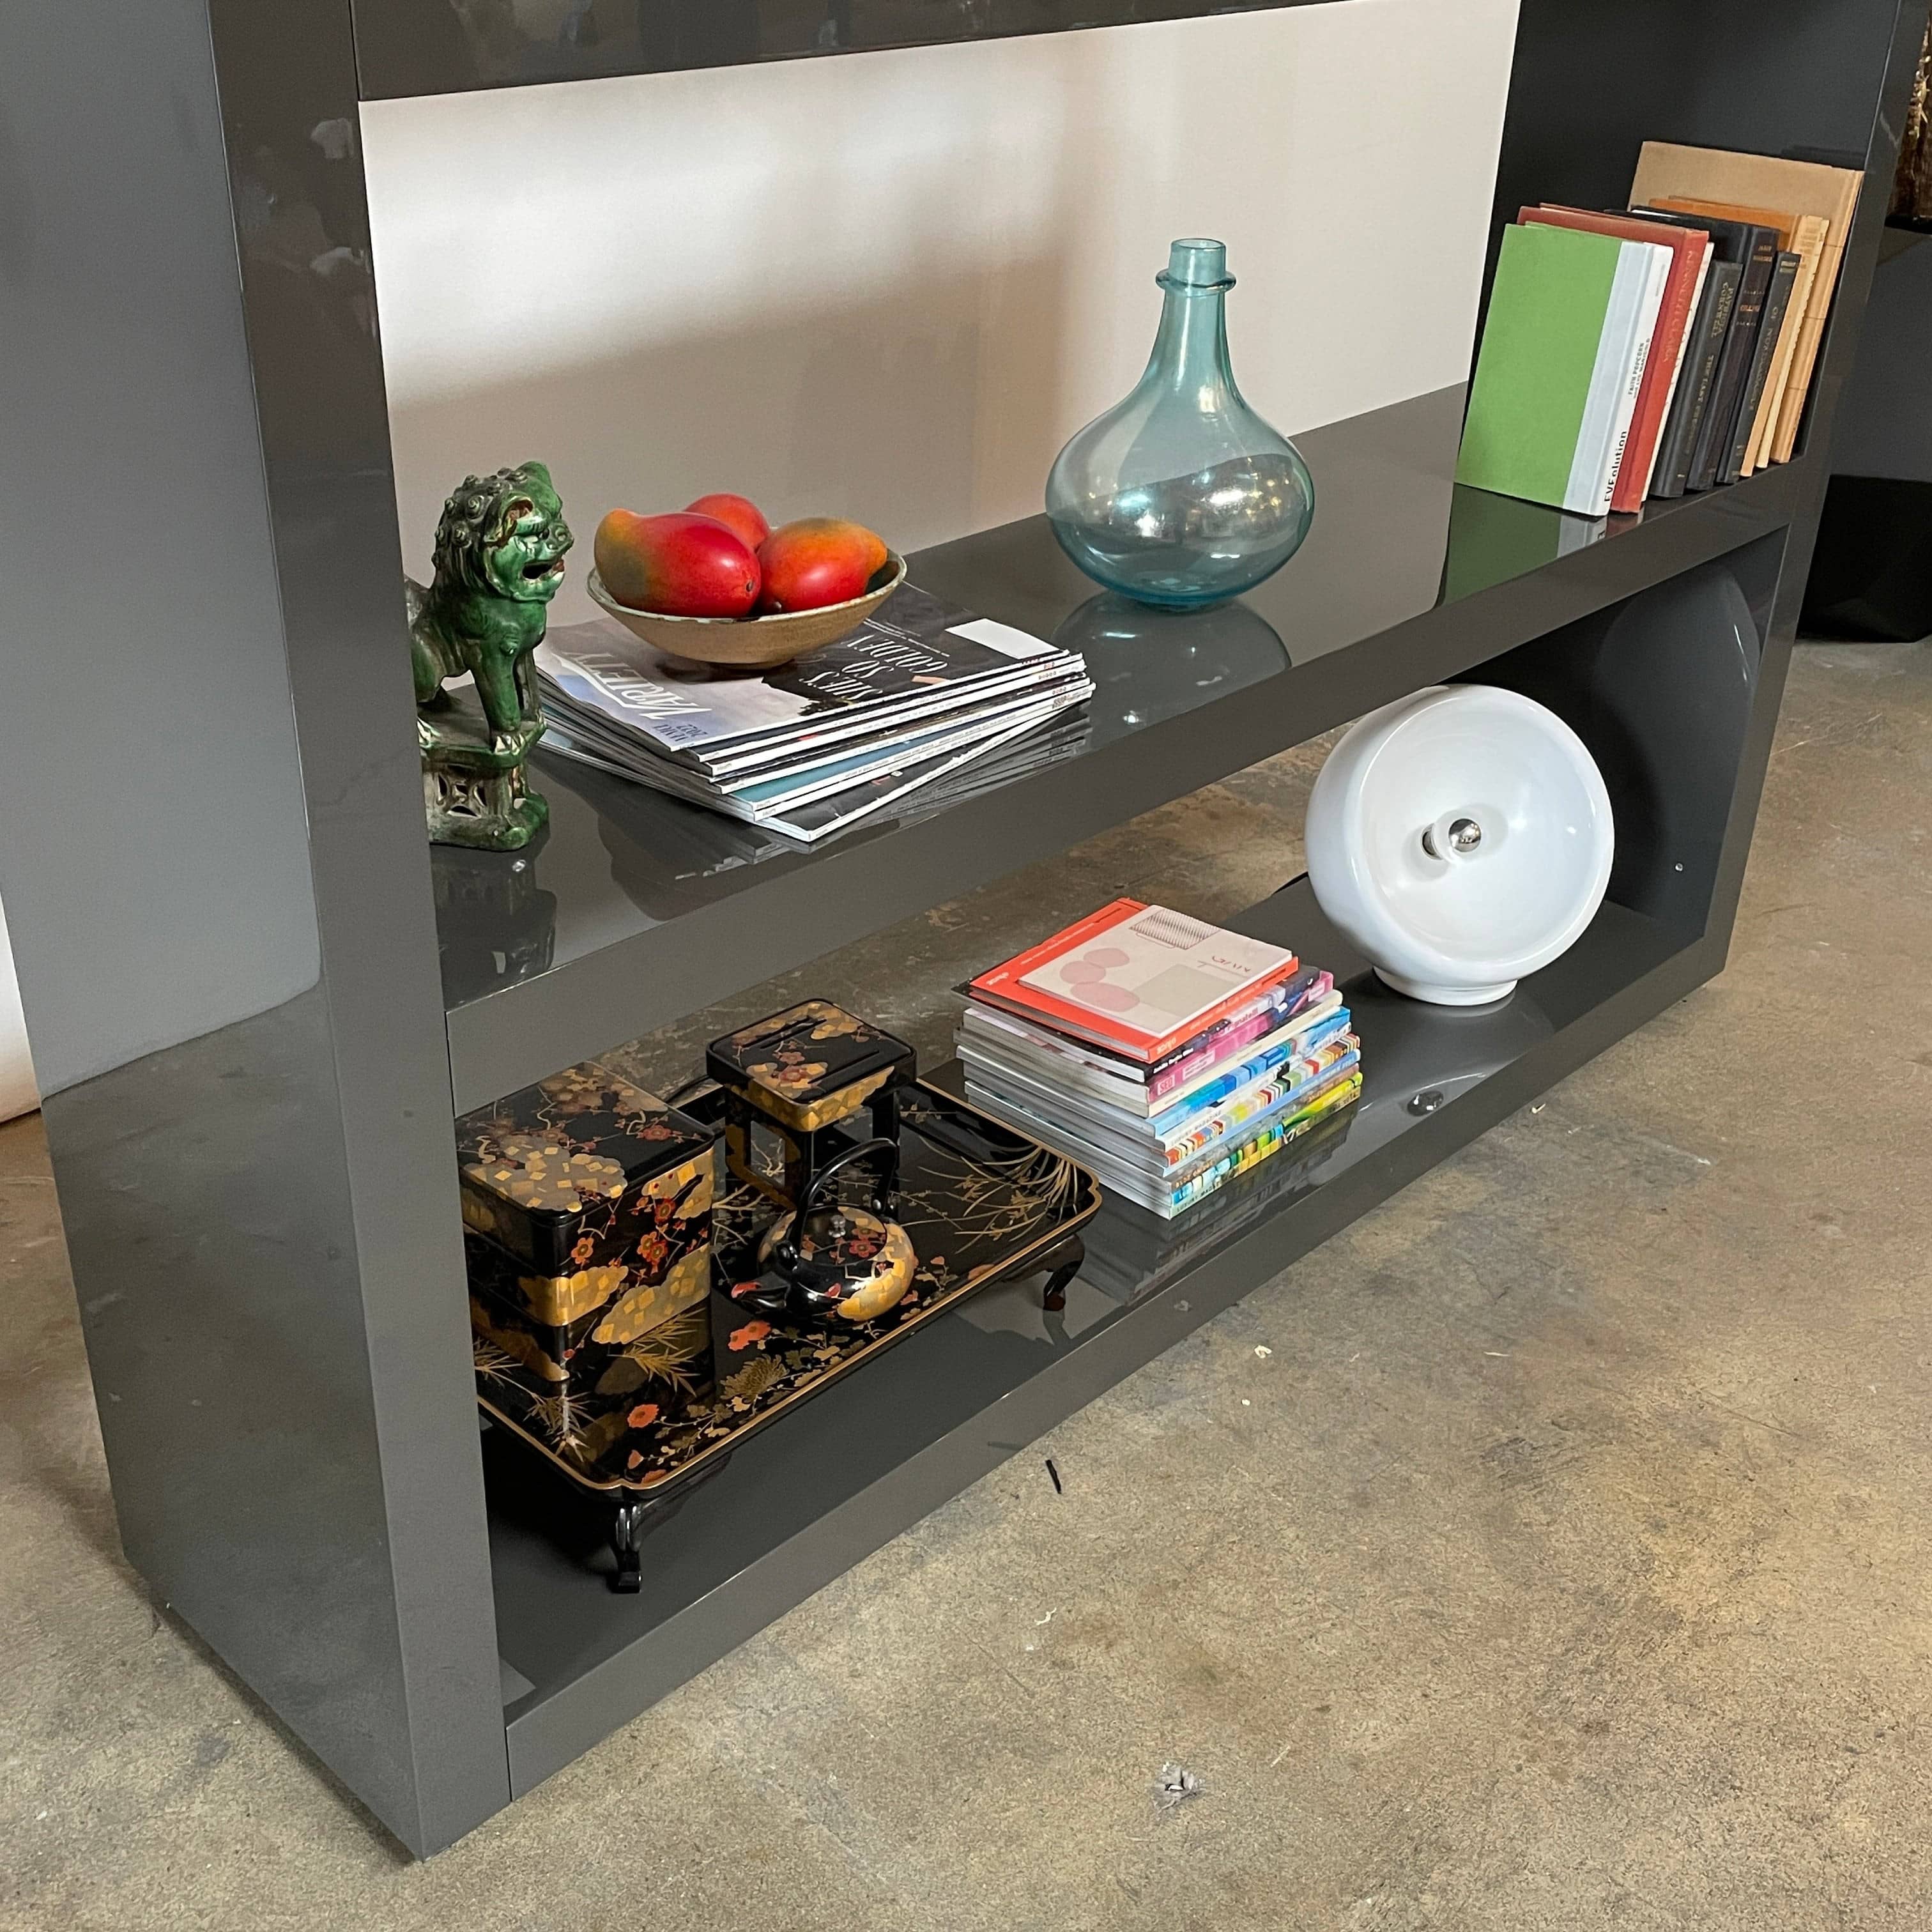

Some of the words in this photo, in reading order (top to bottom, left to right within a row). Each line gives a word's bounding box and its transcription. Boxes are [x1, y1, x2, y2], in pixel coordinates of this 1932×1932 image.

[841, 634, 948, 673] GOLDEN
[842, 660, 894, 678] SO
[551, 652, 712, 719] VARIETY
